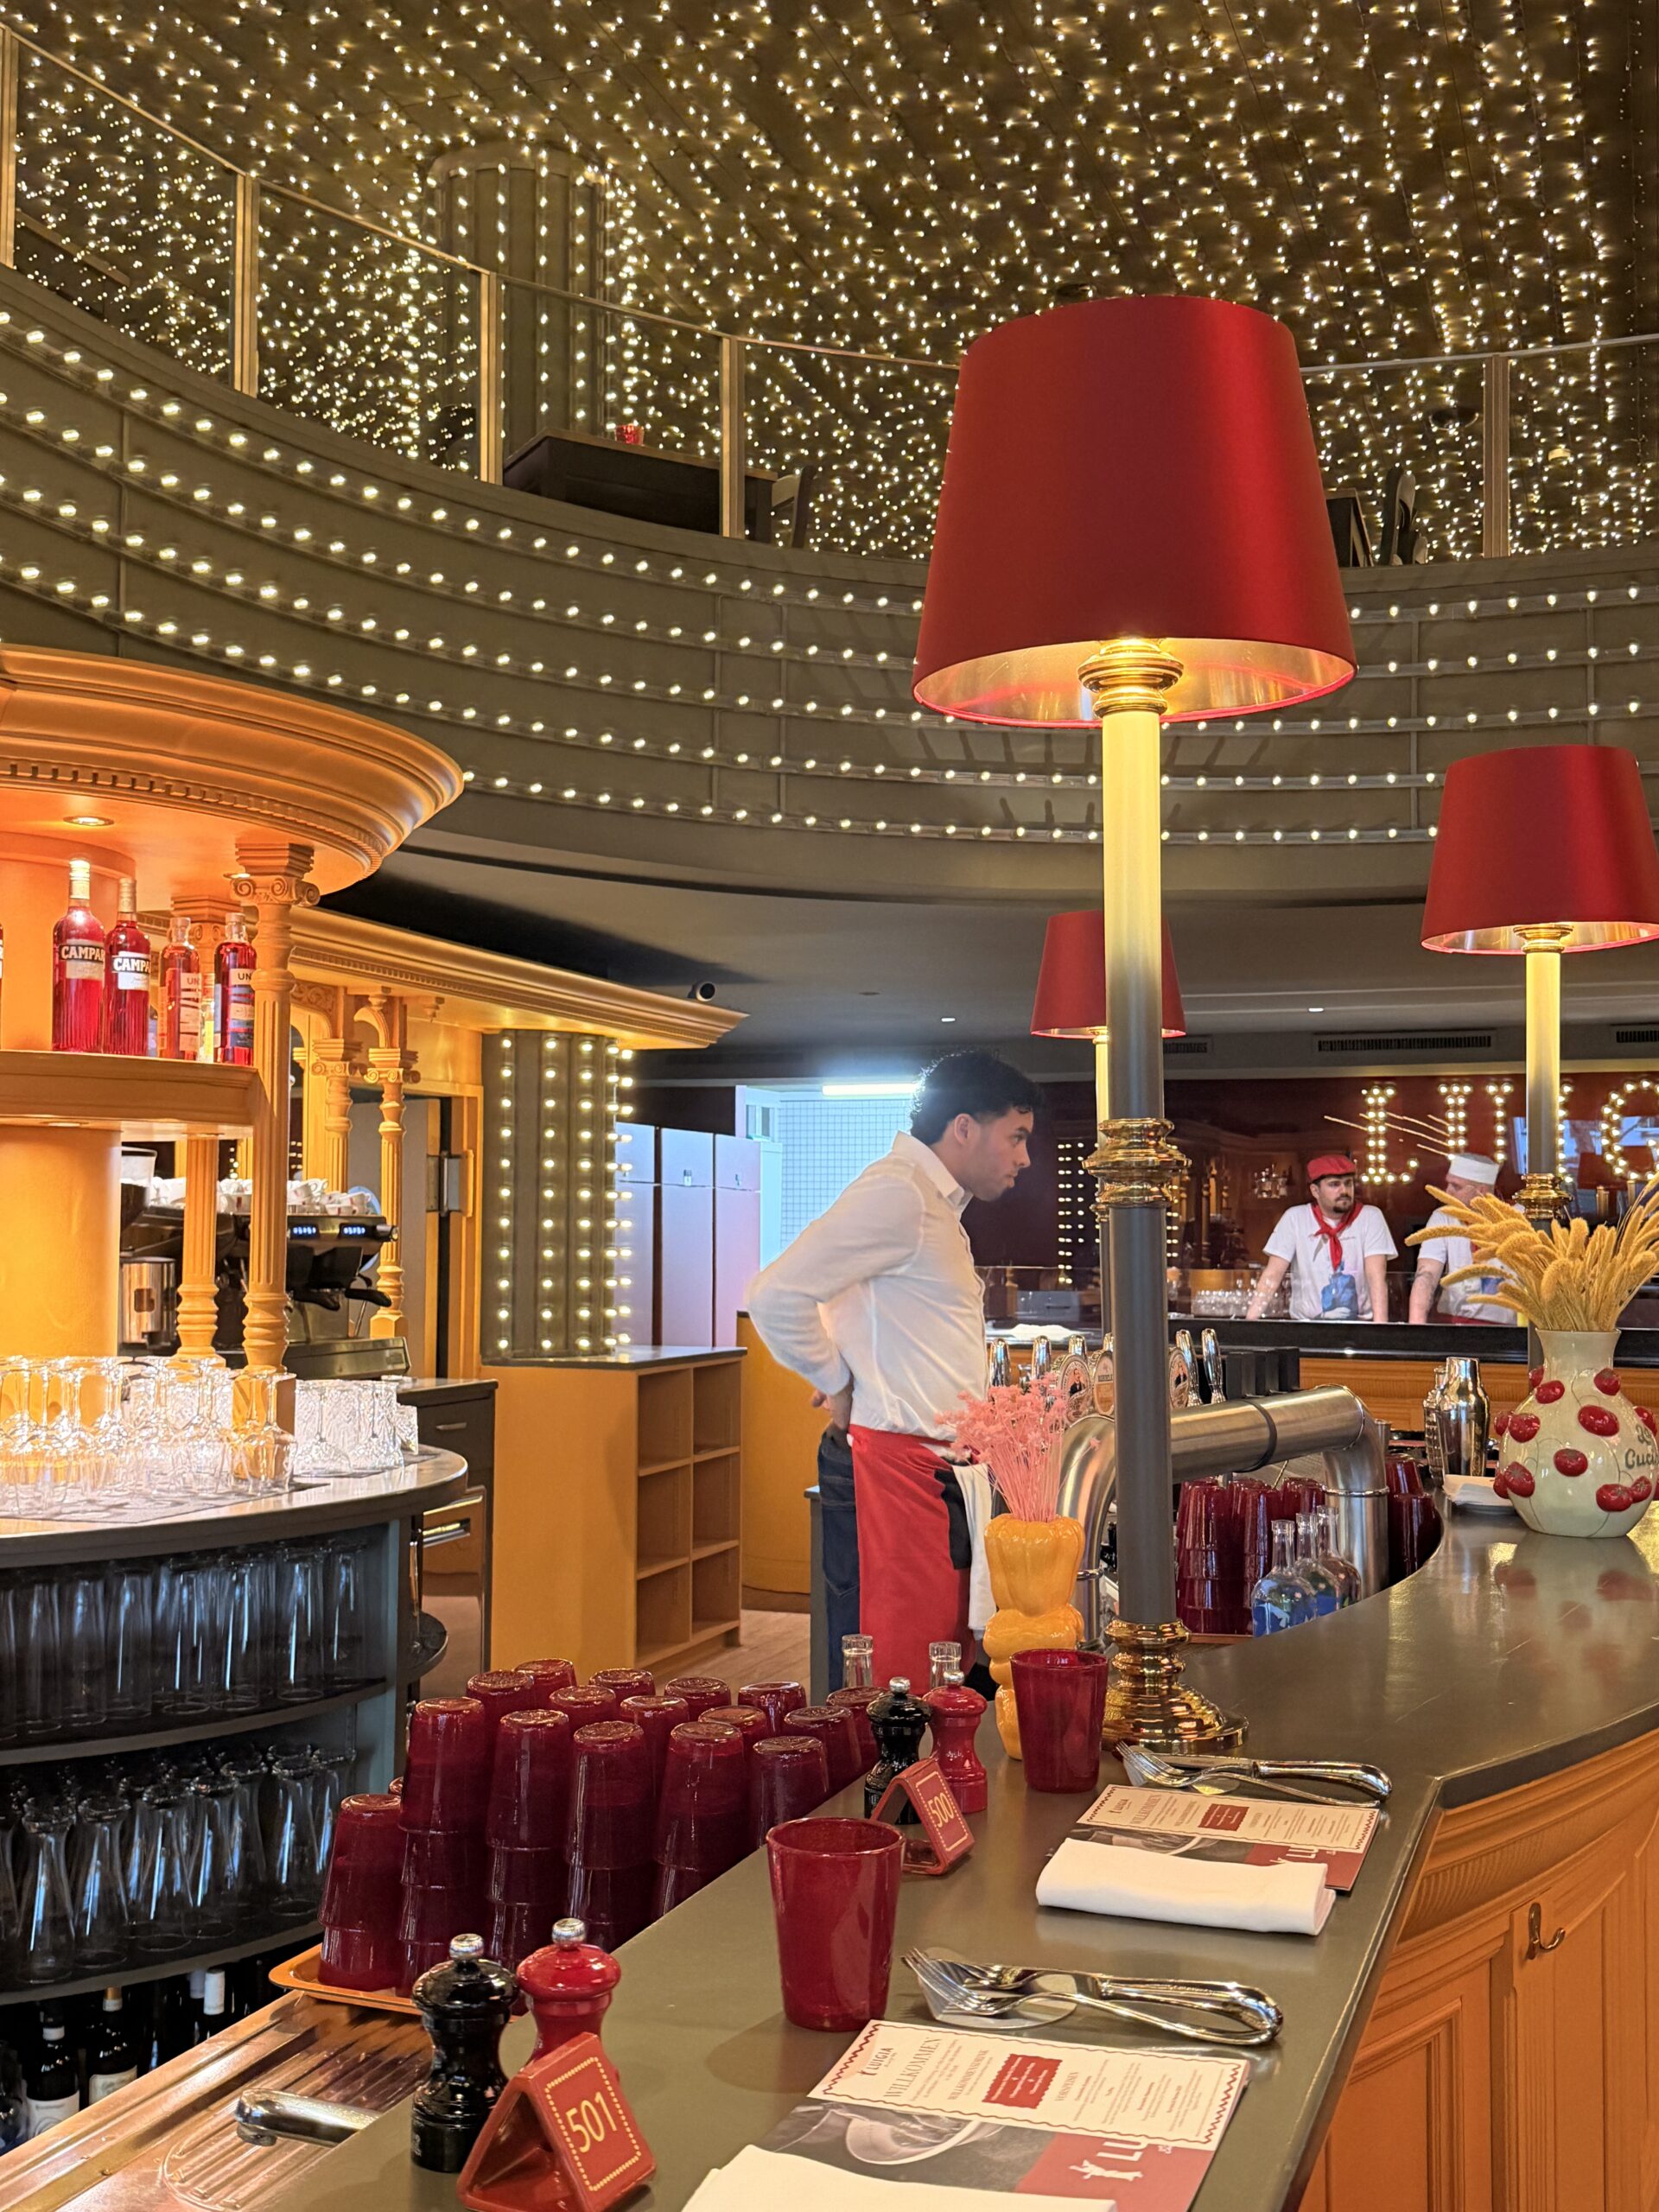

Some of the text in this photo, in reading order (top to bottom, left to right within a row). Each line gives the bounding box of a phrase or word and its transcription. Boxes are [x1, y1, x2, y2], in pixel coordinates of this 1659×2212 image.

[927, 1792, 954, 1828] 500
[865, 2048, 893, 2069] LUIGIA
[882, 2037, 943, 2097] WILLKOMMEN
[565, 2091, 618, 2153] 501
